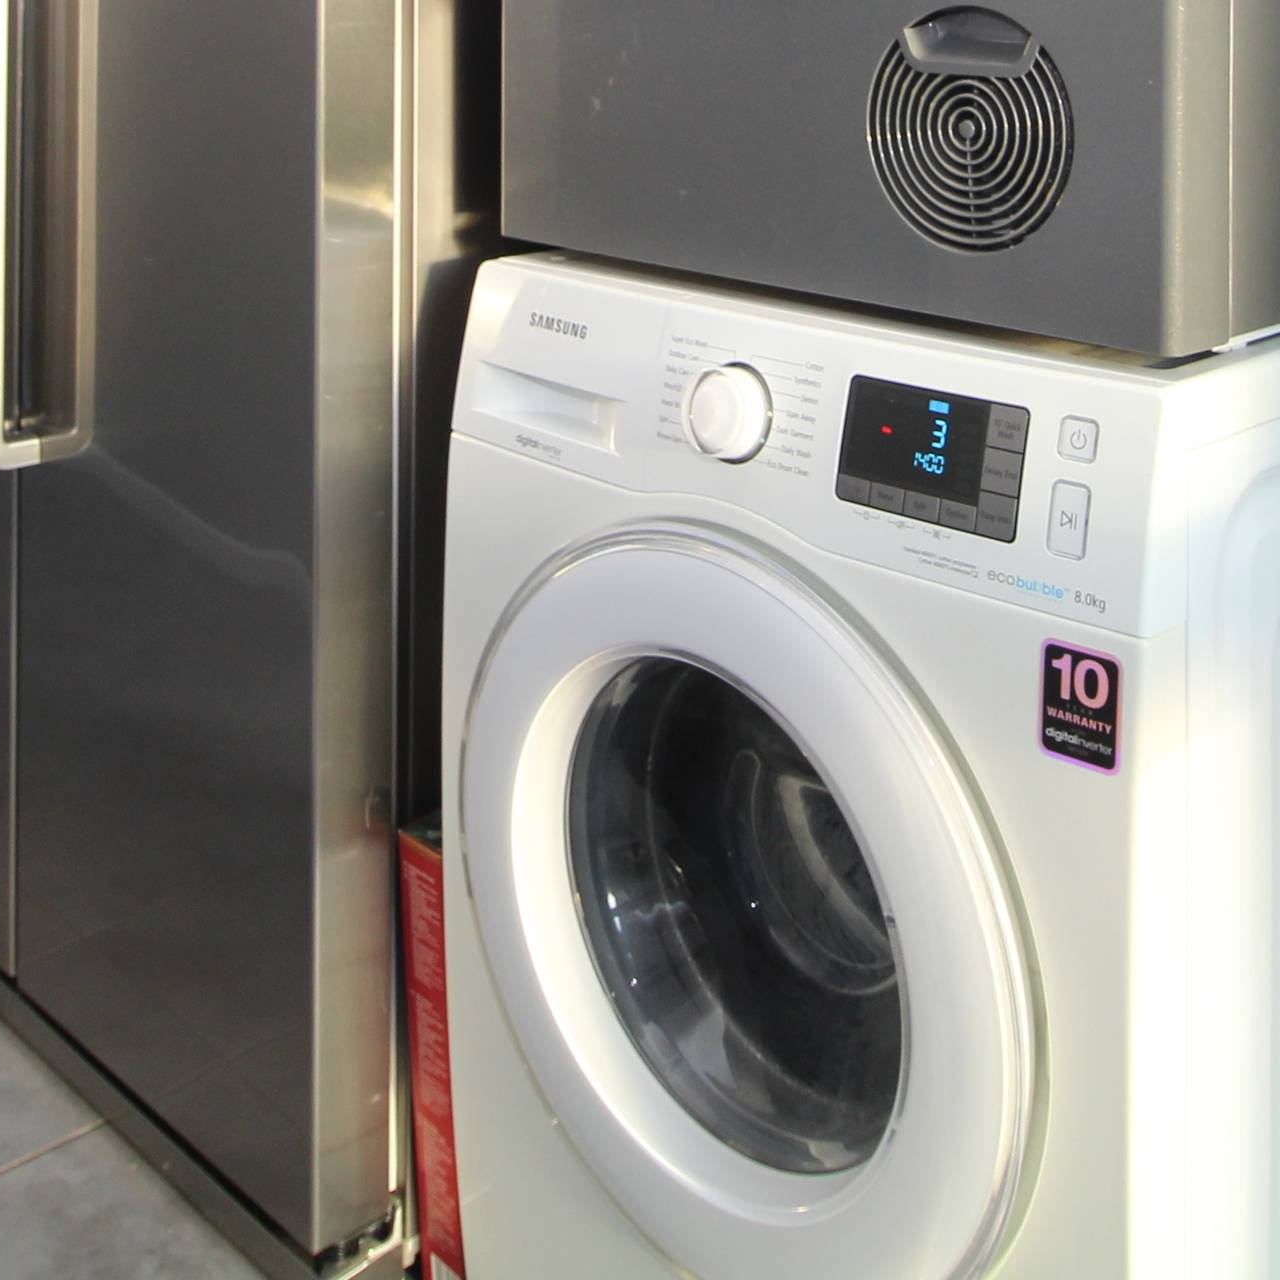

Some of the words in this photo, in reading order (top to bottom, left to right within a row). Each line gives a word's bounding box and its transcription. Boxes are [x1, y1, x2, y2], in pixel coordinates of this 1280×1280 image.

[529, 311, 588, 340] SAMSUNG
[931, 419, 948, 449] 3
[913, 451, 945, 475] 1400
[1073, 589, 1107, 614] 8.0kg
[1051, 653, 1109, 710] 10
[1045, 705, 1113, 735] WARRANTY
